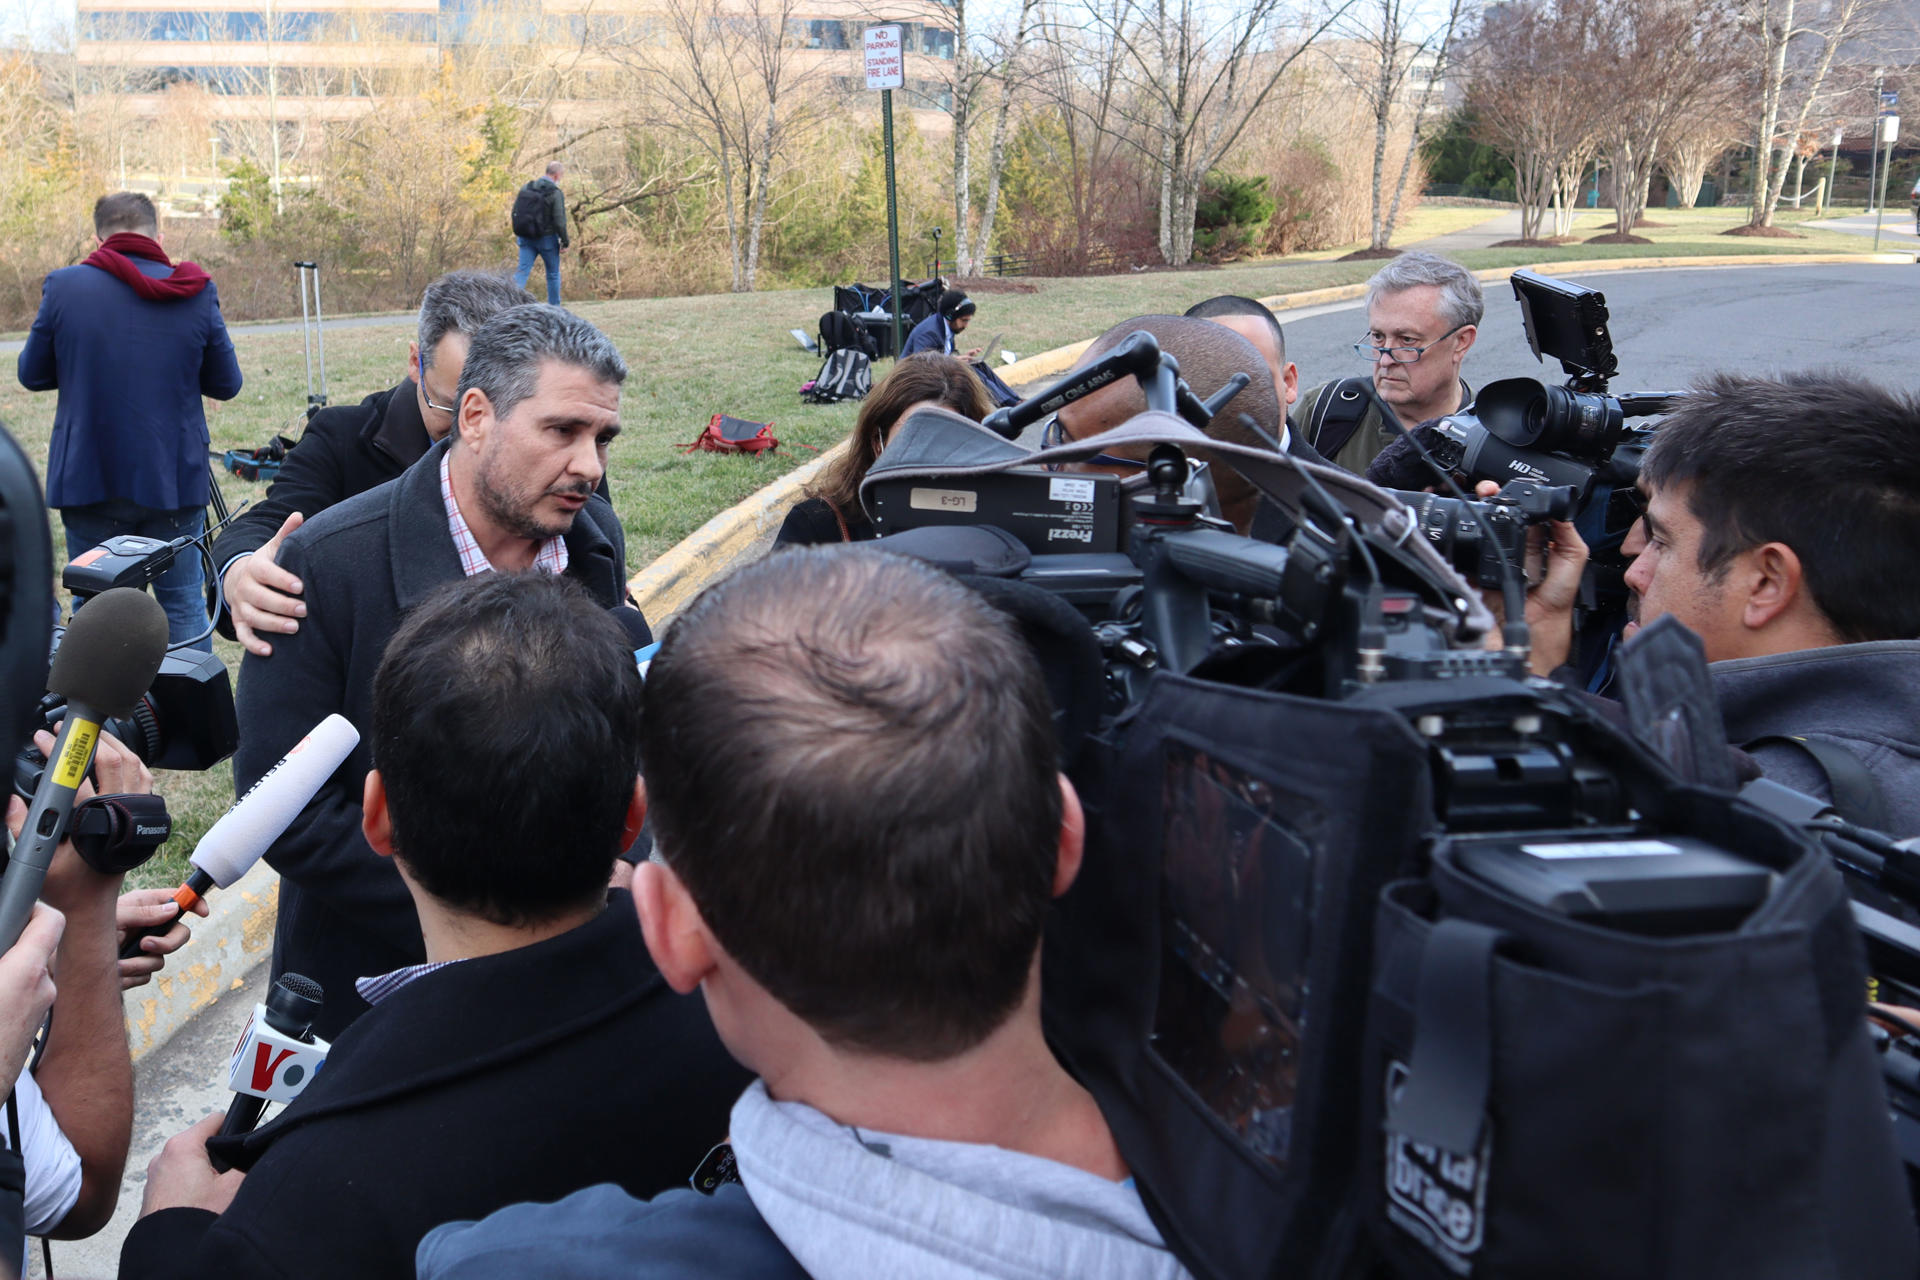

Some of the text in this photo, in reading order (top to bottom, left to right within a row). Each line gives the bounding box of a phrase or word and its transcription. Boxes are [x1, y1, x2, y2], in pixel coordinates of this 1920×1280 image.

[875, 31, 888, 40] NO
[866, 40, 898, 50] PARKING
[867, 56, 899, 67] STANDING
[867, 66, 899, 78] FIRE LANE
[1065, 369, 1115, 400] CINE ARMS
[1508, 459, 1531, 474] HD
[941, 495, 966, 507] LG-3
[1048, 528, 1093, 543] Frezzi
[136, 824, 167, 835] Panasonic
